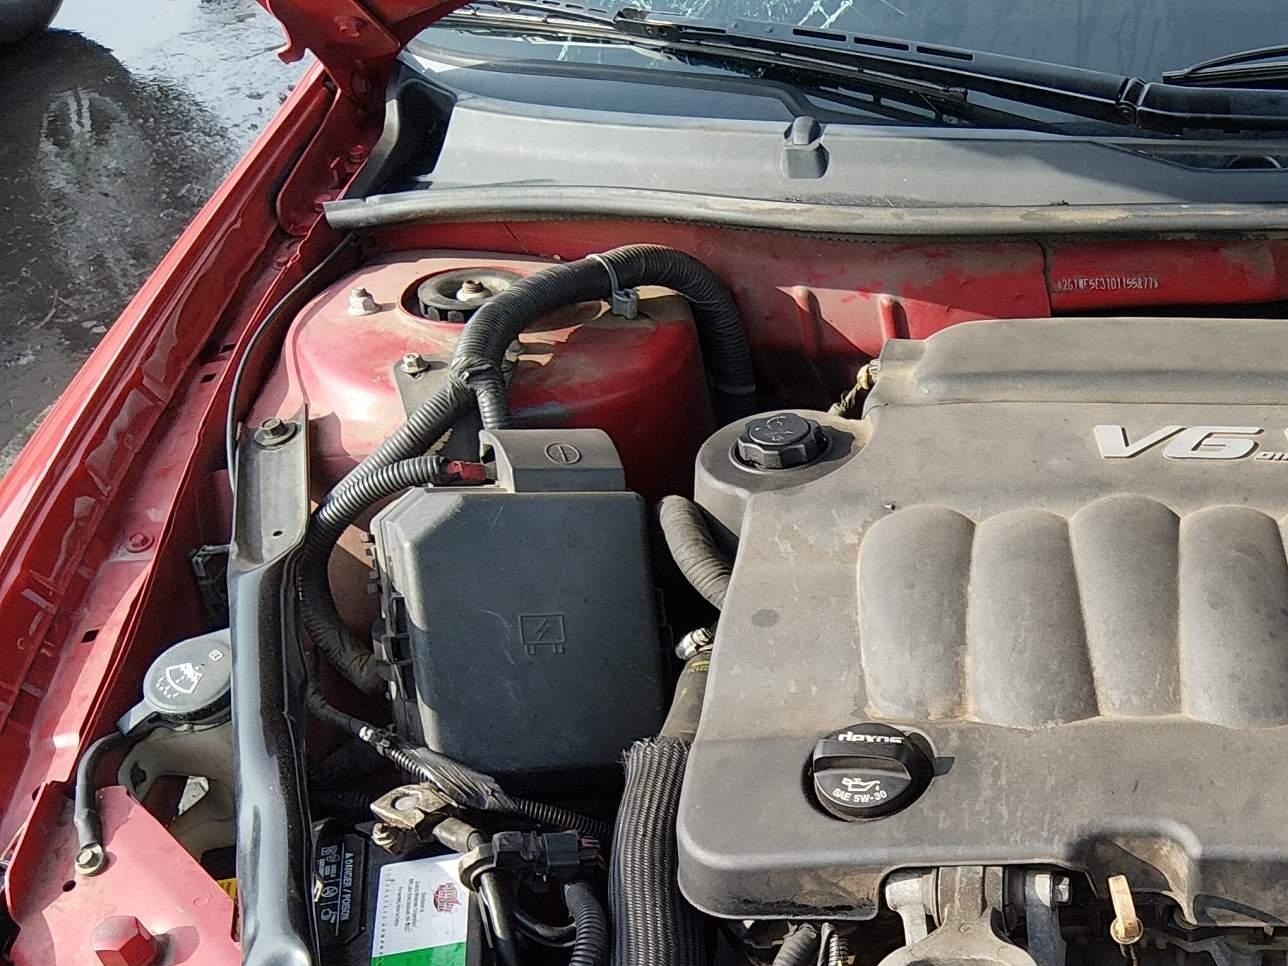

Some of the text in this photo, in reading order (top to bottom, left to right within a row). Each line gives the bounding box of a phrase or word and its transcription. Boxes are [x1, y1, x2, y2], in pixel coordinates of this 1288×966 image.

[1093, 424, 1265, 460] V6
[832, 788, 888, 803] SAE 5W-30
[342, 859, 354, 888] DANGER
[340, 894, 352, 921] POISON
